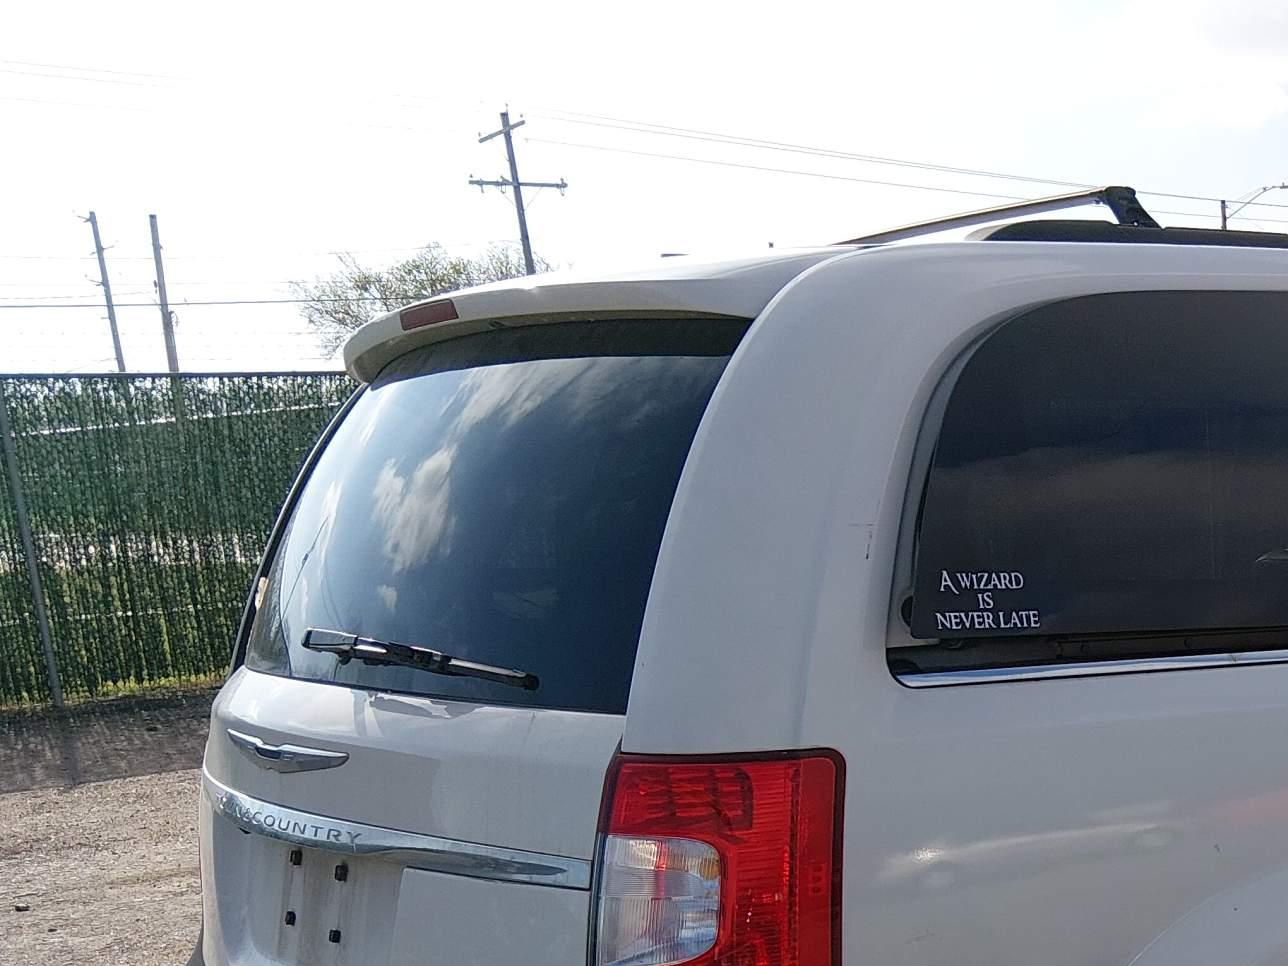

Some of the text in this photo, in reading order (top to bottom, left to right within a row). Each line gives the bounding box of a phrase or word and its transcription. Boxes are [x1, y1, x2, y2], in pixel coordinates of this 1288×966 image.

[940, 570, 1024, 594] A WIZARD
[977, 592, 994, 609] IS
[935, 611, 1040, 630] NEVER LATE
